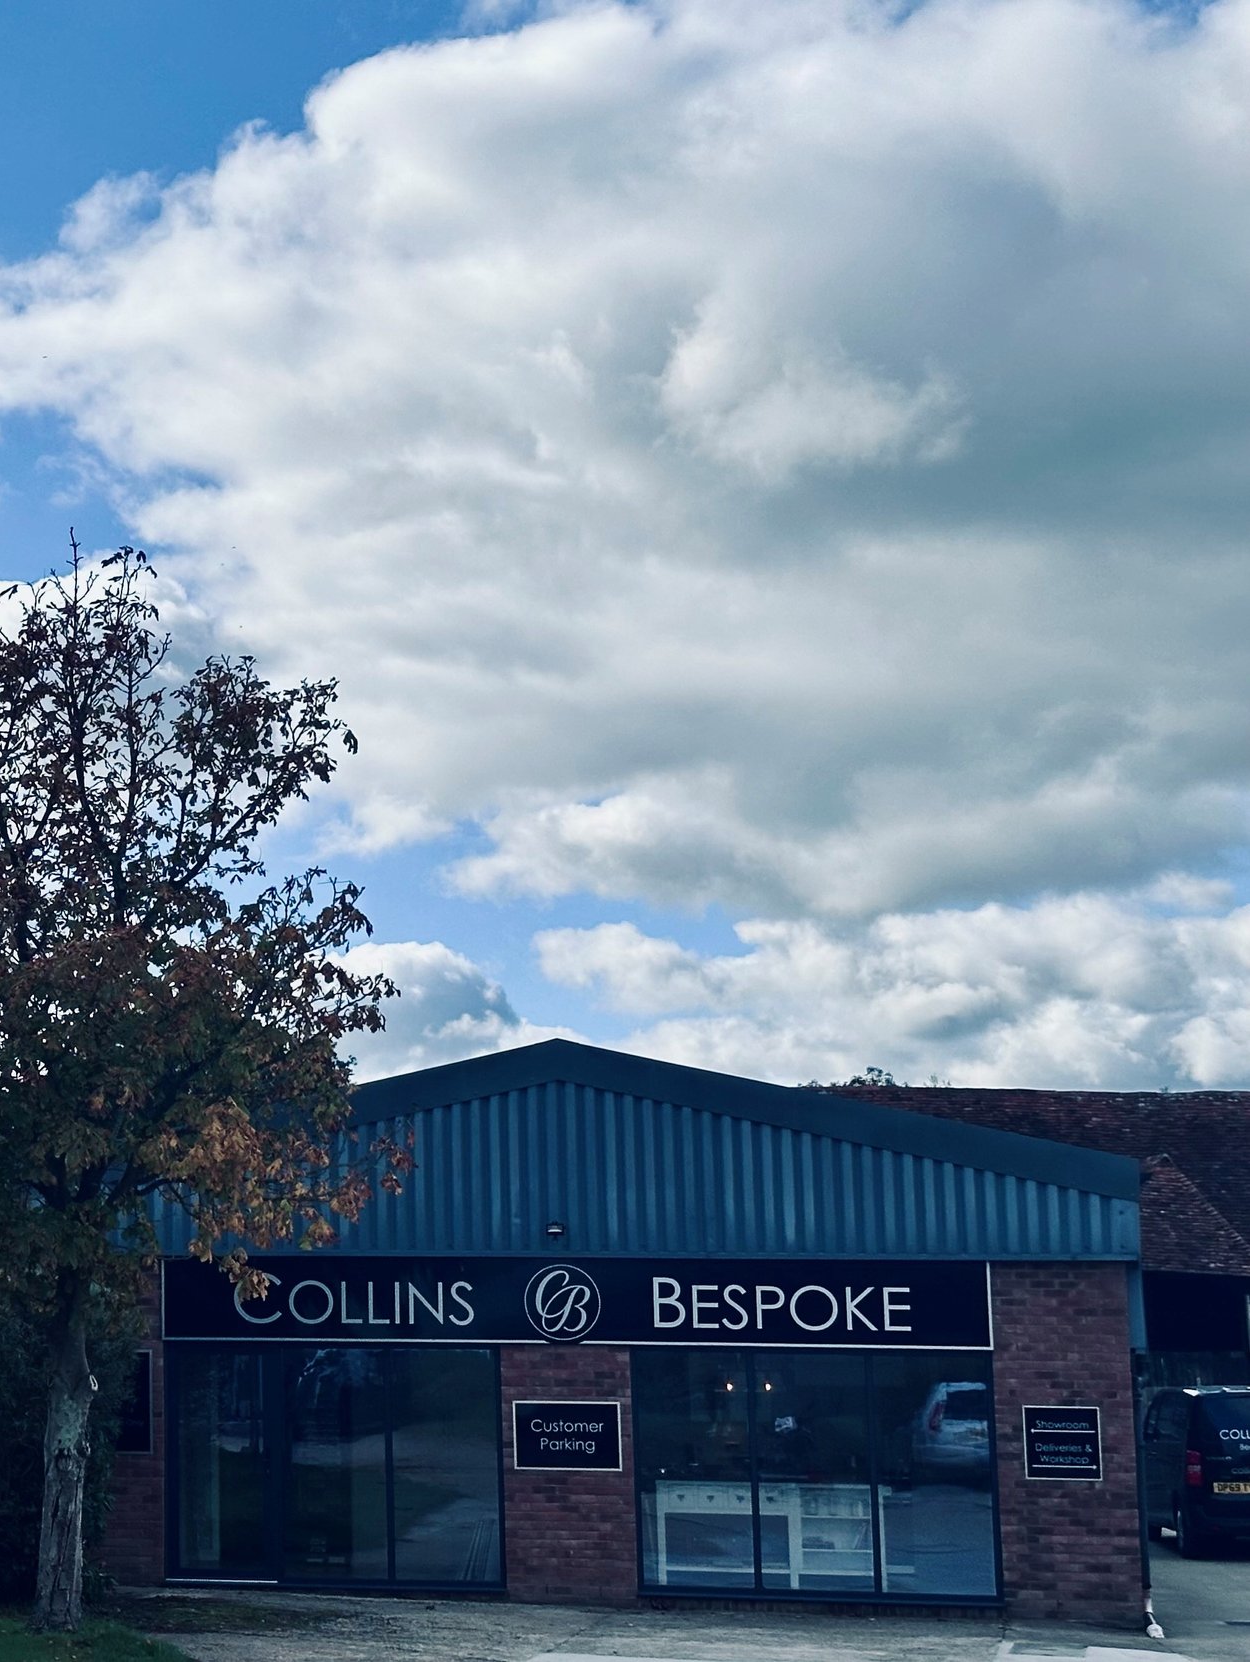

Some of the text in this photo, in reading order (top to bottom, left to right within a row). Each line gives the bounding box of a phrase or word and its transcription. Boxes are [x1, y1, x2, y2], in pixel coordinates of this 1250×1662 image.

[233, 1271, 475, 1326] COLLINS
[652, 1276, 912, 1332] BESPOKE
[530, 1418, 604, 1433] Customer
[1035, 1419, 1089, 1430] Showroom
[540, 1437, 596, 1454] Parking
[1034, 1442, 1093, 1453] Deliveries &
[1039, 1454, 1089, 1465] Workshop
